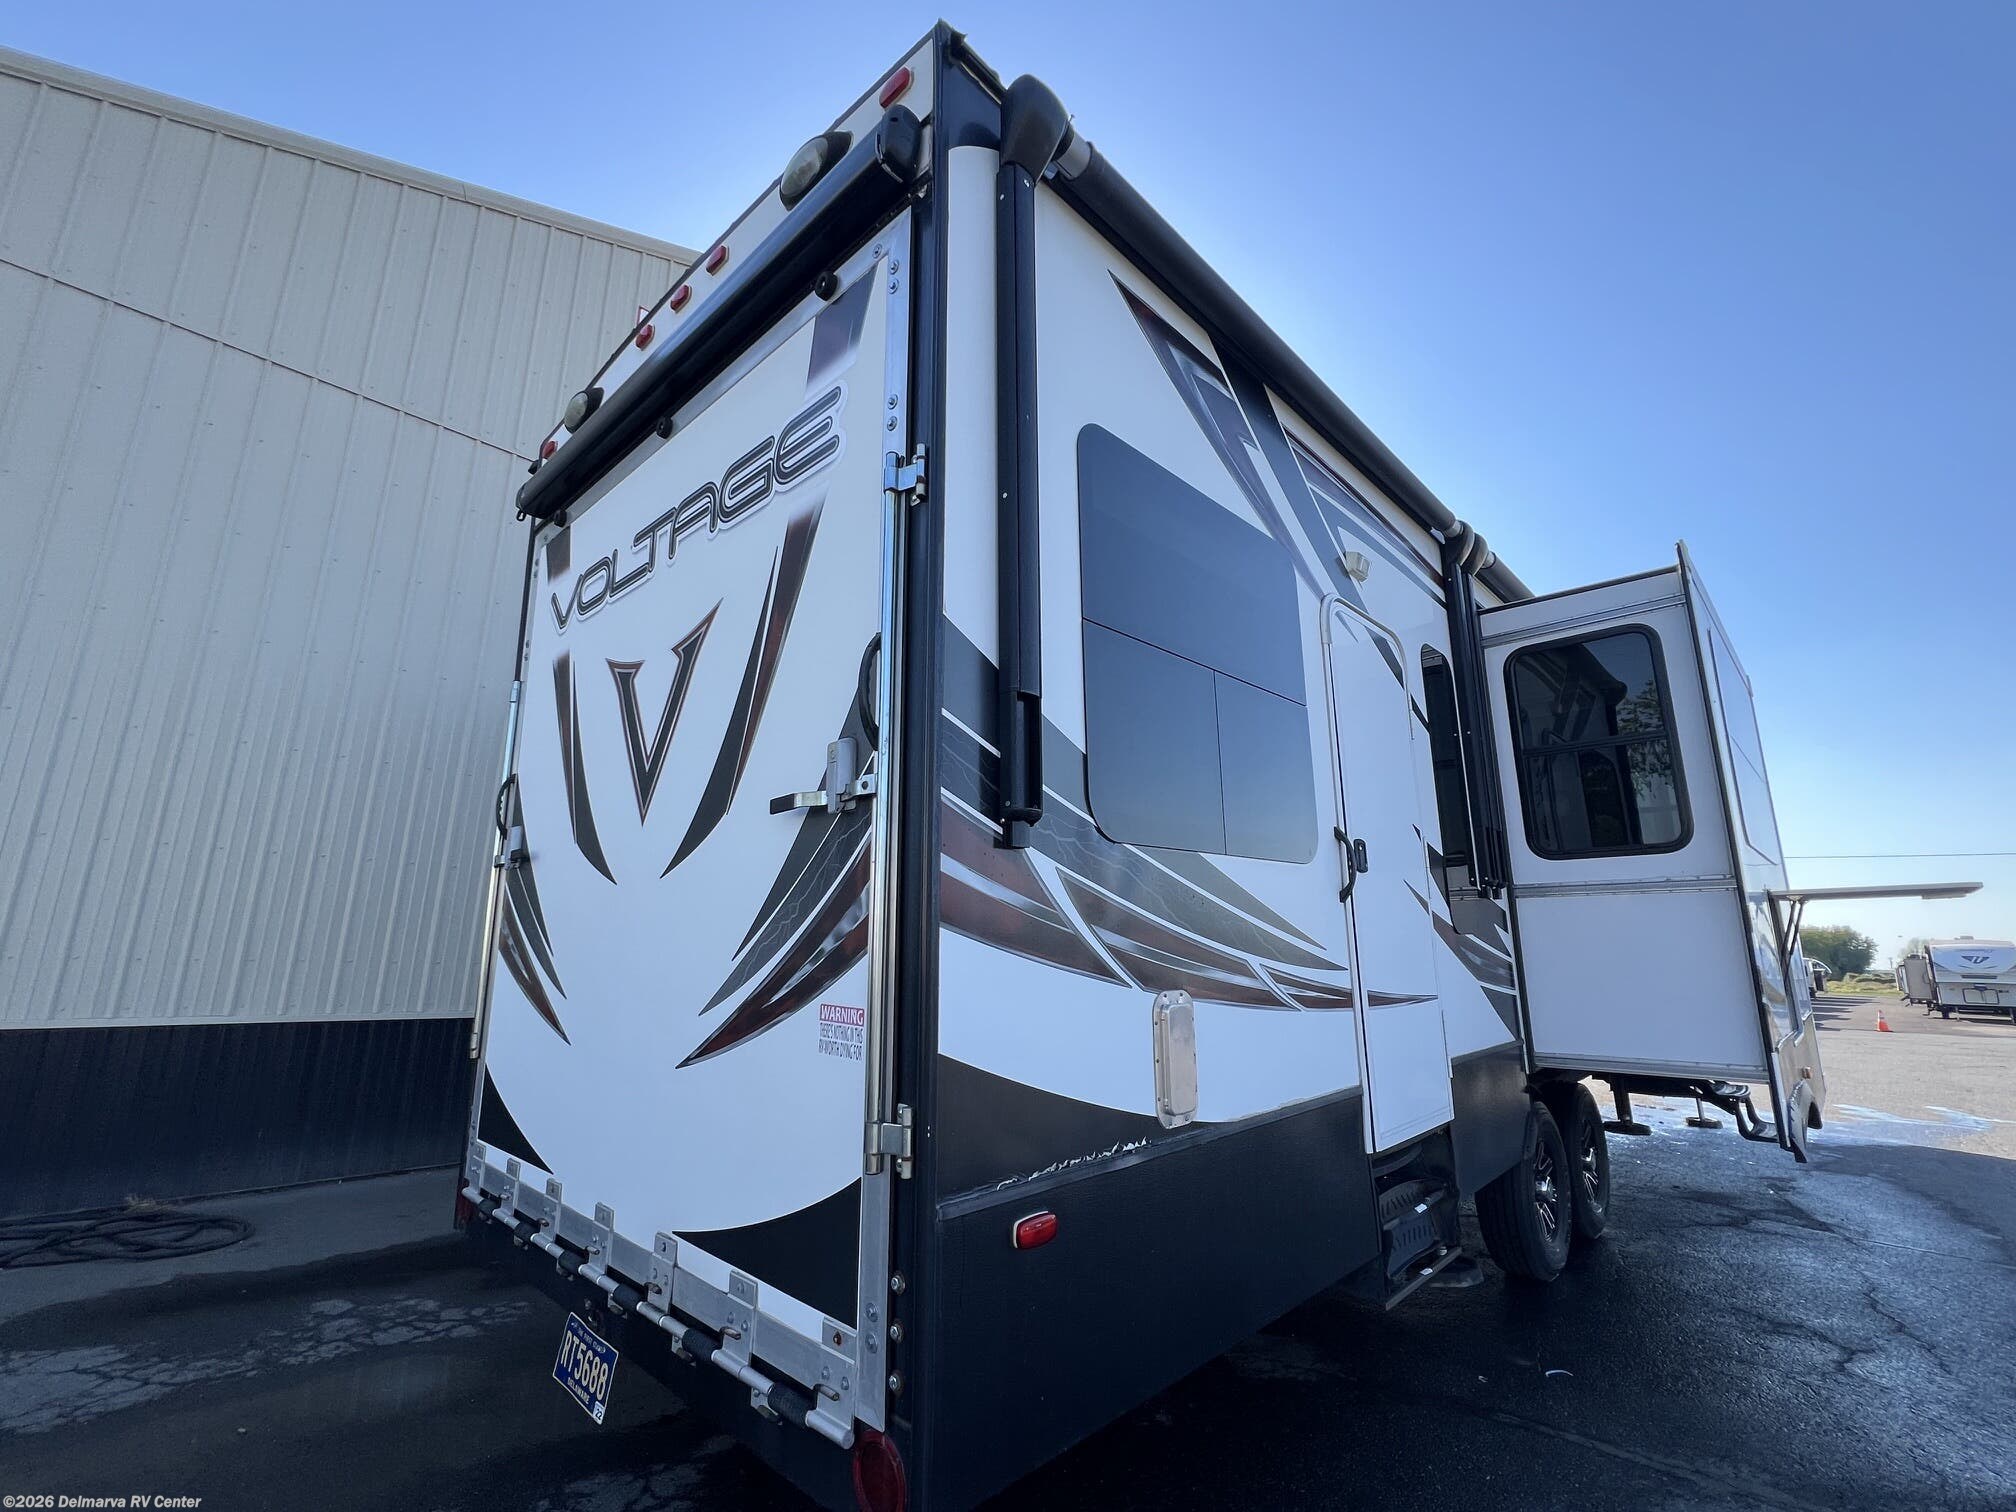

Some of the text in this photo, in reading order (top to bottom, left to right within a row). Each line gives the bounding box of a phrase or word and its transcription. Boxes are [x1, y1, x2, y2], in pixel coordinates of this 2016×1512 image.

[551, 386, 842, 630] VOLTAGE
[820, 1004, 864, 1026] WARNING
[560, 1330, 609, 1401] RT5688
